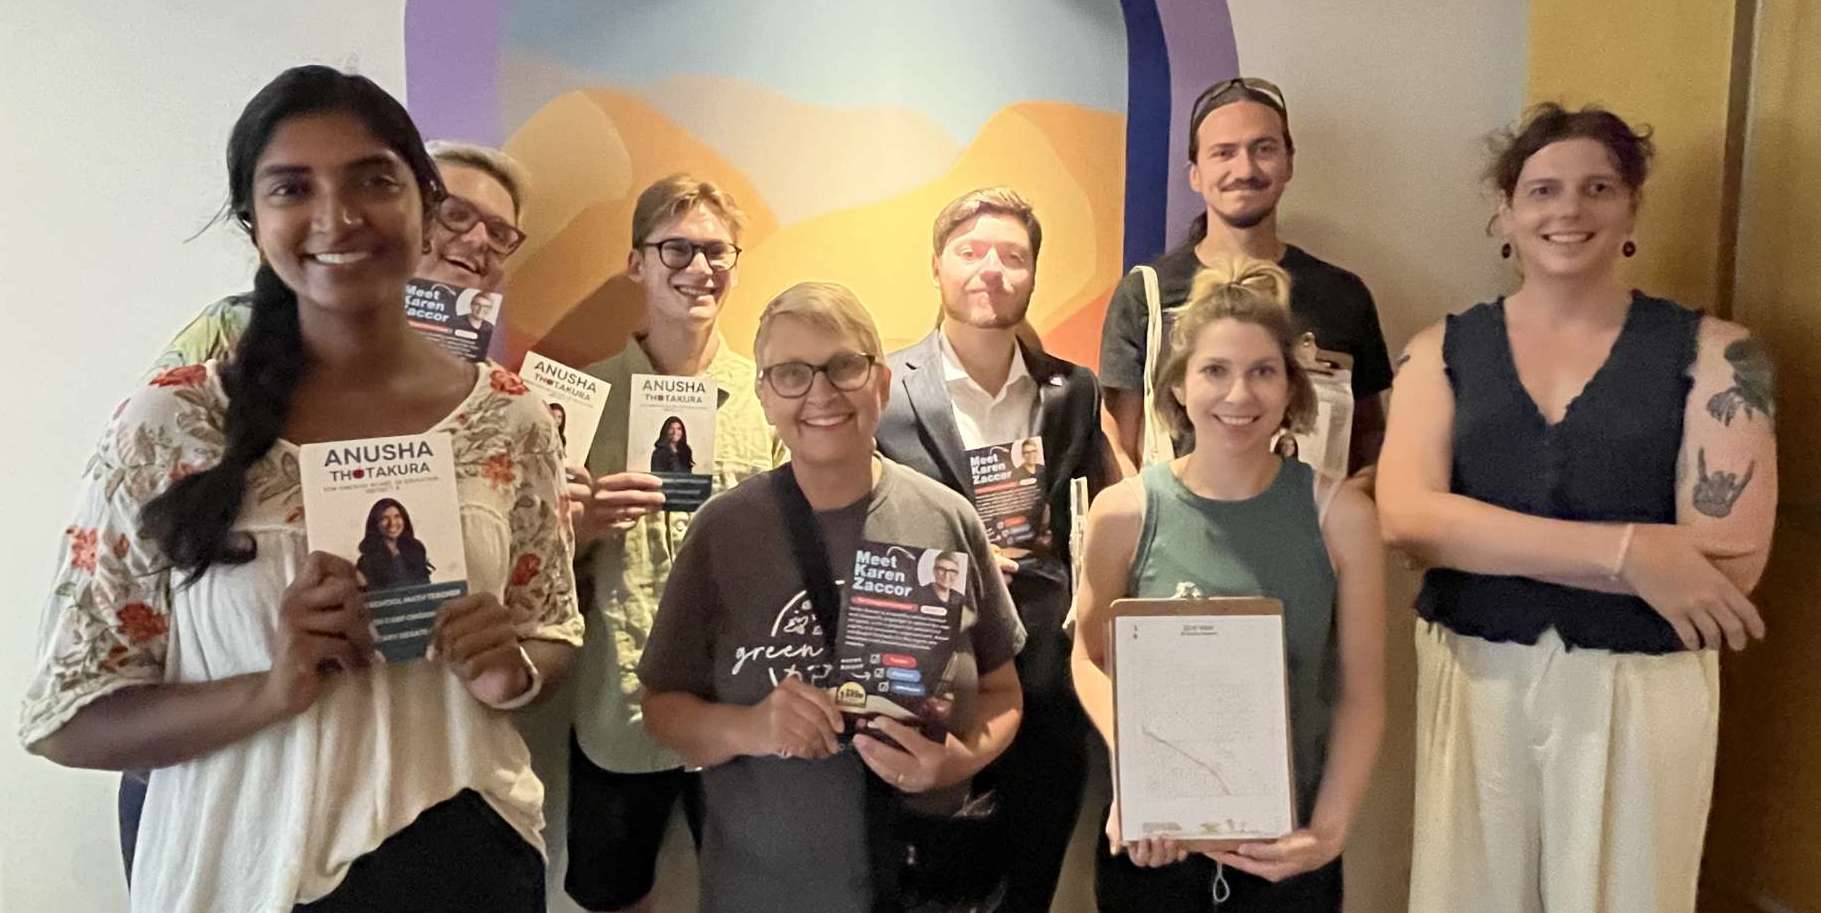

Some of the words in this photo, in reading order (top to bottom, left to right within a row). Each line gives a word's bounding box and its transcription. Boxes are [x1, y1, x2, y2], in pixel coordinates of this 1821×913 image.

[534, 361, 597, 393] ANUSHA
[642, 380, 706, 393] ANUSHA
[324, 440, 434, 467] ANUSHA
[970, 453, 998, 467] Meet
[971, 463, 1006, 476] Karen
[972, 471, 1013, 485] Zaccor
[855, 550, 898, 569] Meet
[854, 564, 906, 583] Karen
[852, 576, 913, 597] Zaccor
[732, 644, 824, 675] green
